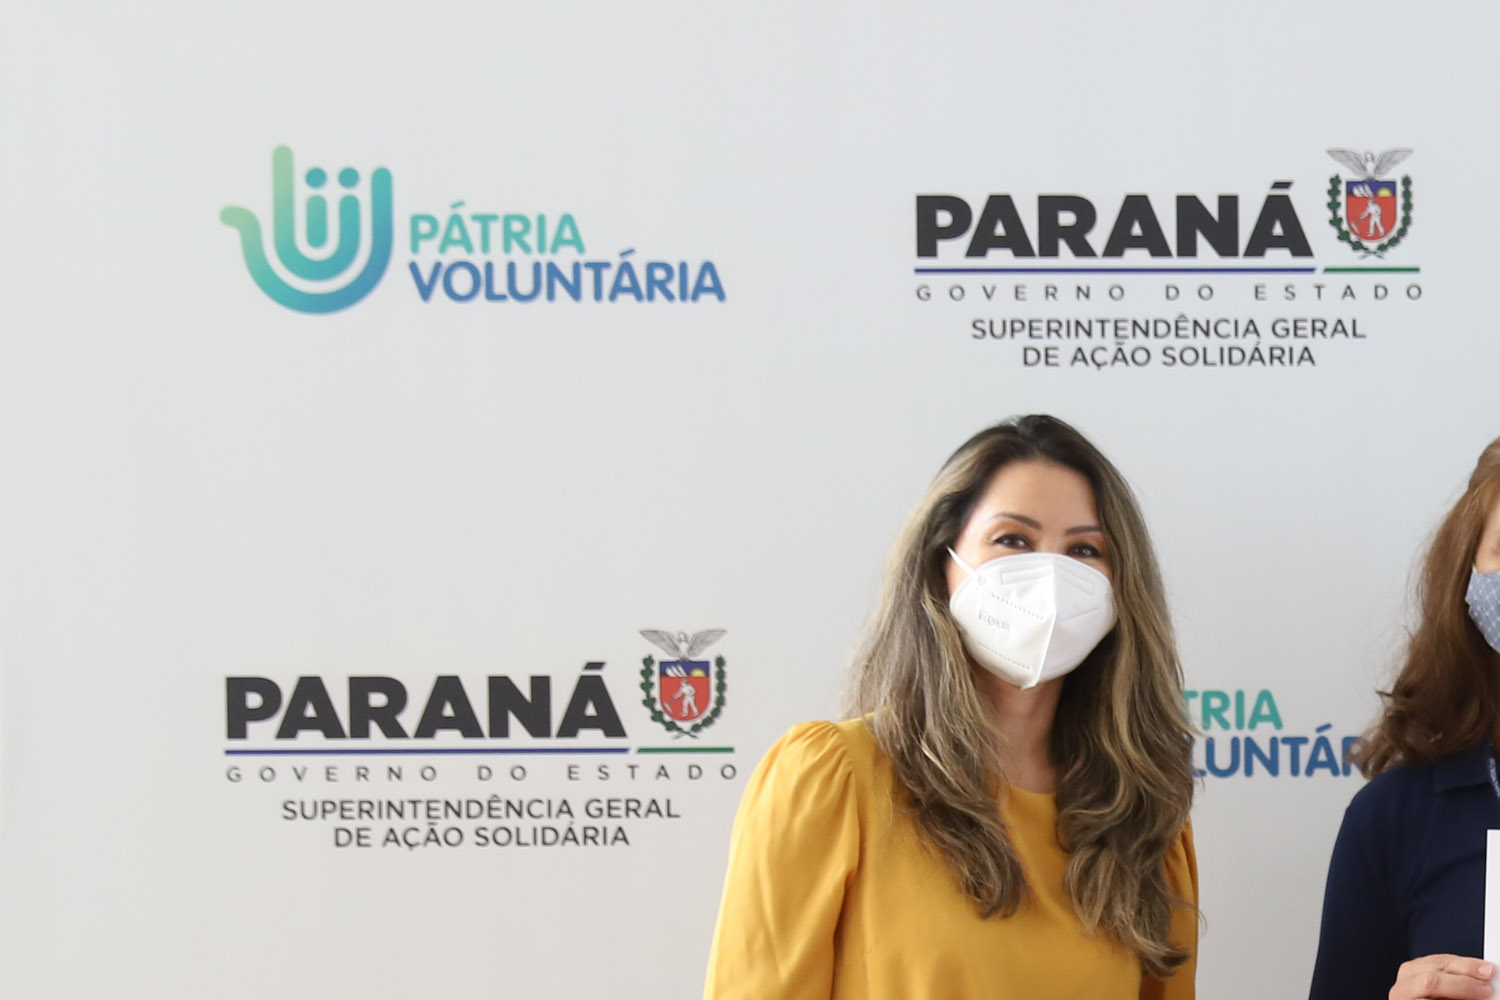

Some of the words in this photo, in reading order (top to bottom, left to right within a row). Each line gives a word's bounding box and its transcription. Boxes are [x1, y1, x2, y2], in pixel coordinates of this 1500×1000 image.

[410, 201, 586, 254] PÁTRIA
[916, 181, 1314, 258] PARANÁ
[409, 249, 726, 303] VOLUNTÁRIA
[916, 285, 1125, 301] GOVERNO
[1165, 285, 1214, 301] DO
[1255, 284, 1422, 301] ESTADO
[971, 314, 1260, 340] SUPERINTENDÊNCIA
[1271, 318, 1367, 339] GERAL
[1022, 345, 1060, 367] DE
[1070, 341, 1152, 370] AÇÃO
[1161, 341, 1316, 367] SOLIDÁRIA
[225, 662, 627, 740] PARANÁ
[226, 766, 437, 783] GOVERNO
[477, 765, 527, 781] DO
[568, 764, 737, 781] ESTADO
[282, 794, 575, 821] SUPERINTENDÊNCIA
[584, 799, 681, 819] GERAL
[334, 827, 372, 848] DE
[382, 822, 464, 851] AÇÃO
[474, 822, 630, 847] SOLIDÁRIA
